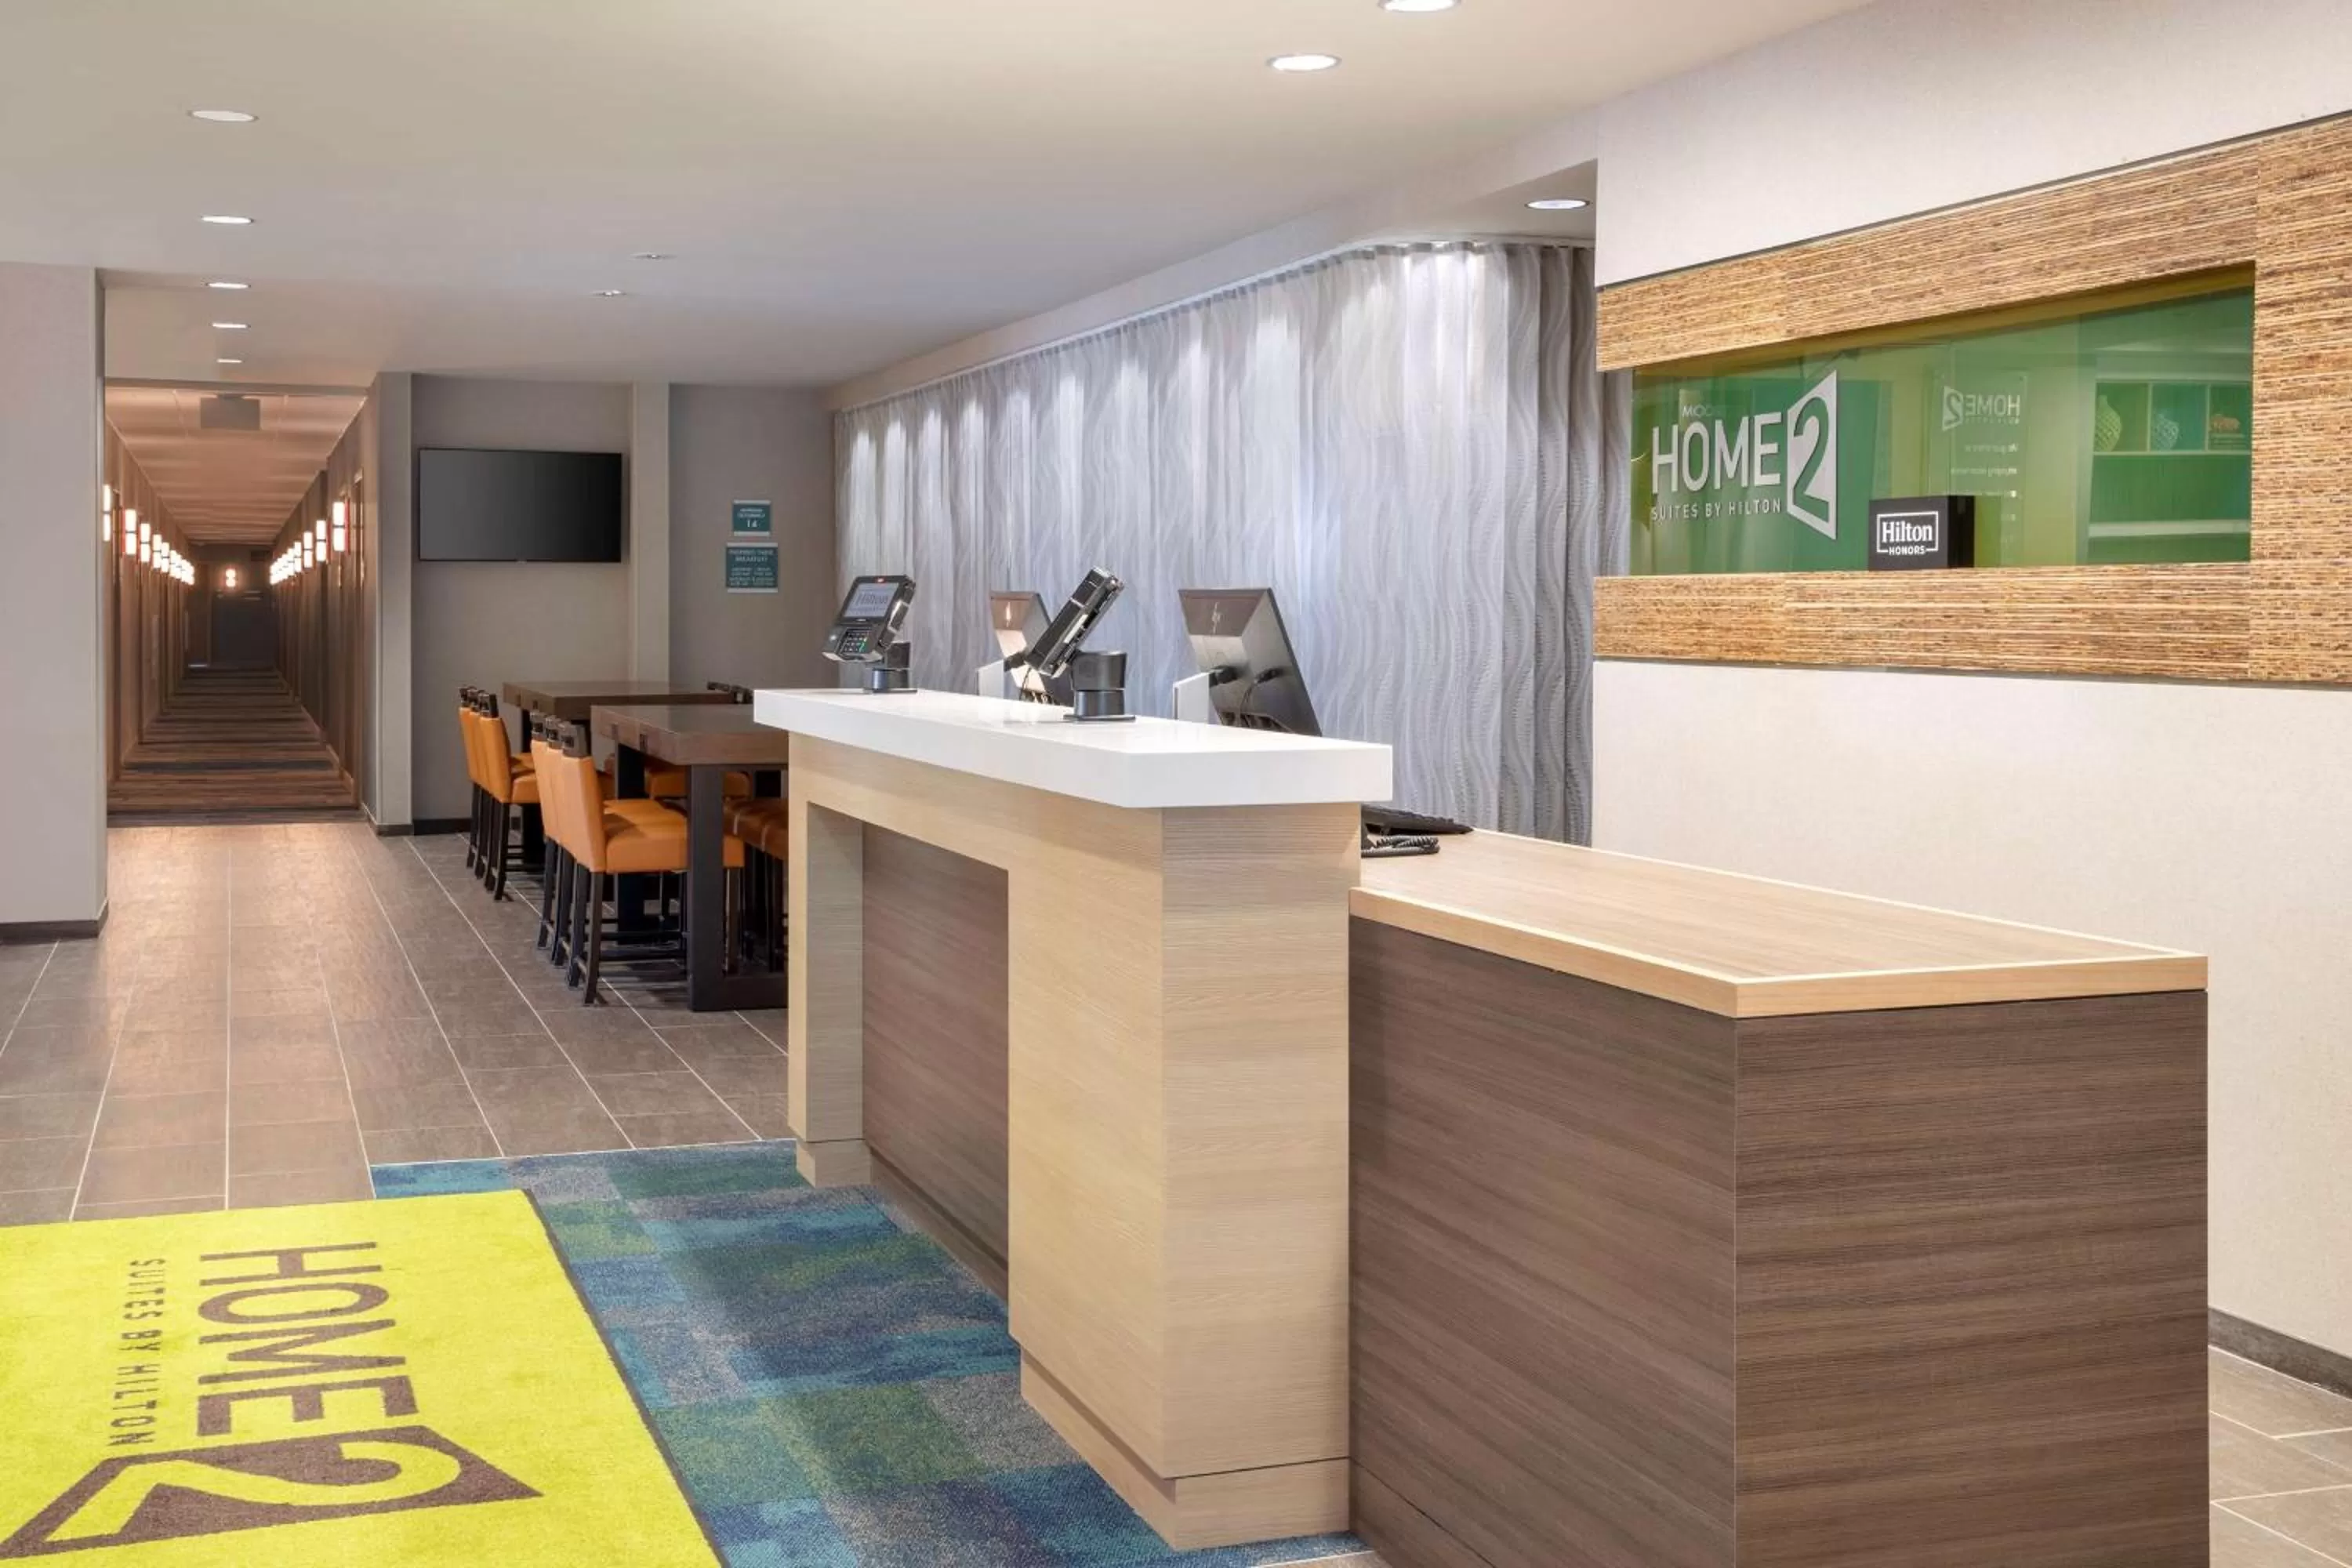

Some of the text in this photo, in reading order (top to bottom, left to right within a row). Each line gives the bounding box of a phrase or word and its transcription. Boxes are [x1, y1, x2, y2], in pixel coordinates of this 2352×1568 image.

[1651, 498, 1781, 521] SUITES BY HILTON
[1882, 521, 1933, 543] Hilton
[1889, 545, 1926, 556] HONORS
[107, 1258, 166, 1446] SUITES BY HILTON
